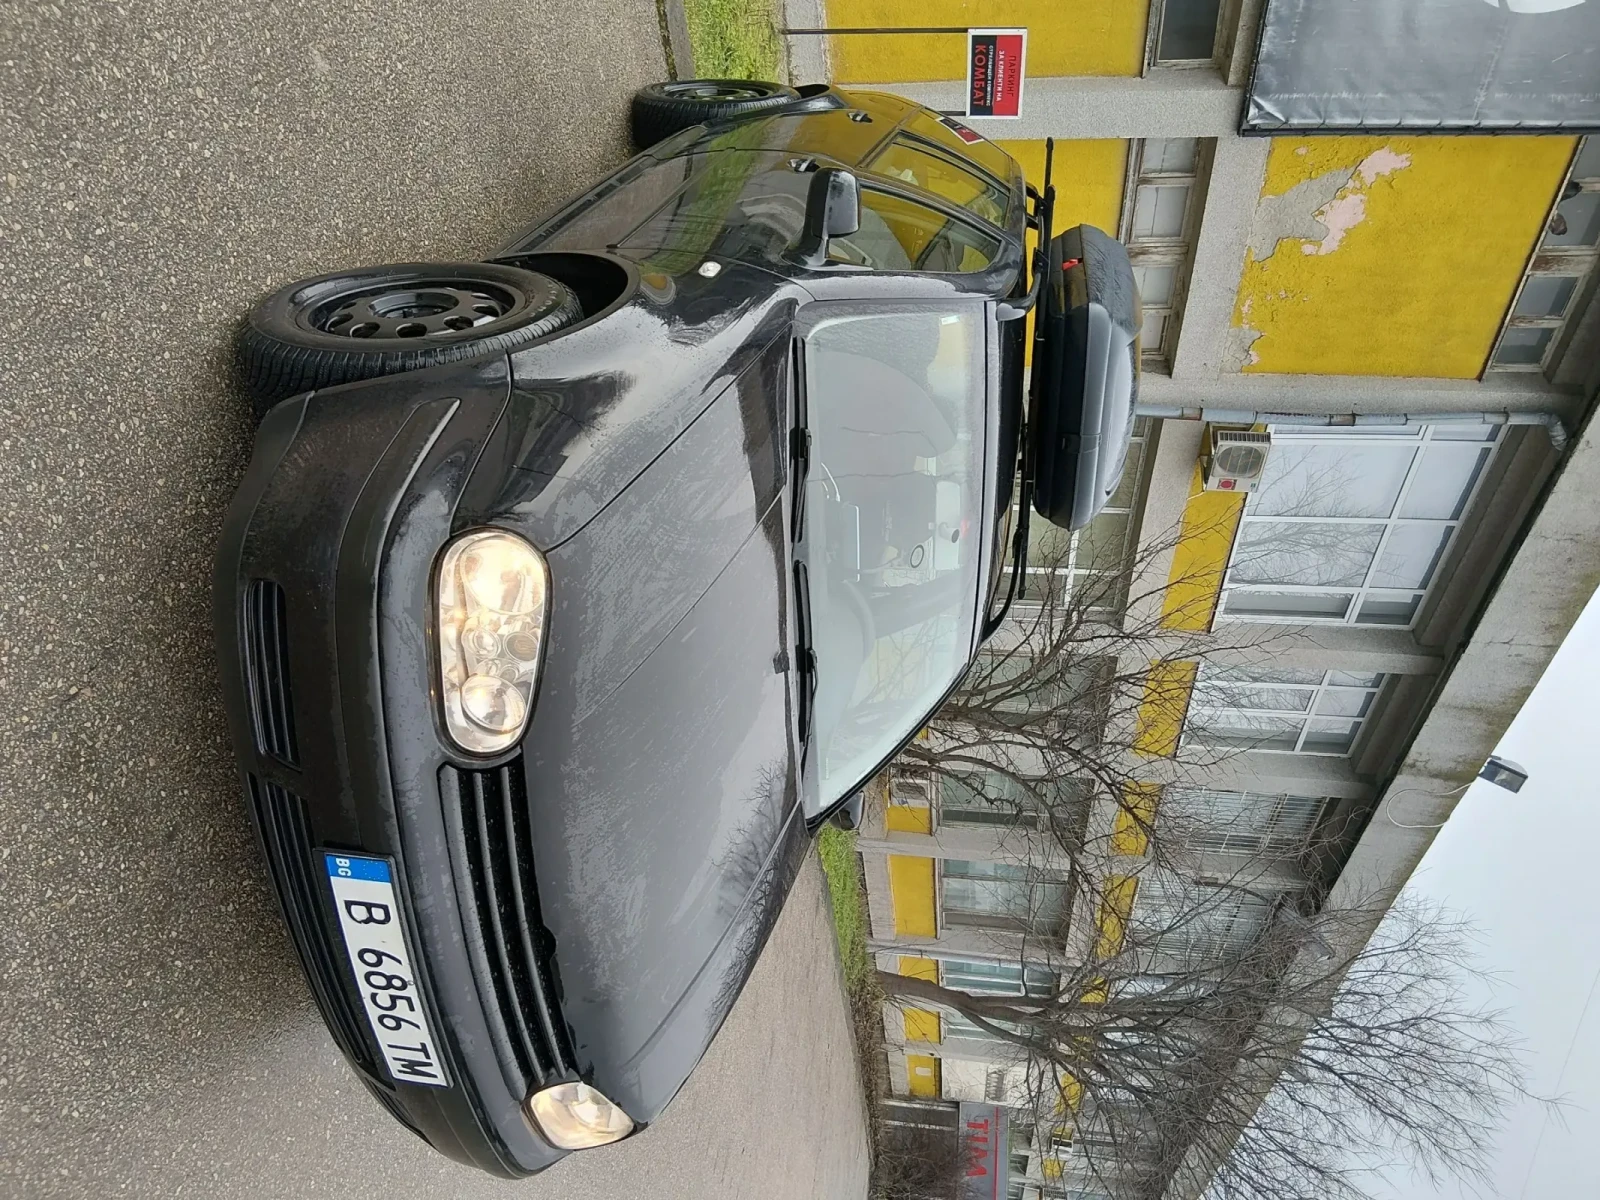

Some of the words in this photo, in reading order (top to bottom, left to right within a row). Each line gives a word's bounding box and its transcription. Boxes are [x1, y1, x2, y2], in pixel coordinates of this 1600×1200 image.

[998, 50, 1004, 60] ЗА
[973, 45, 986, 105] КОМБАТ
[1007, 55, 1017, 96] ПАРКИНГ
[996, 92, 1002, 102] НА
[336, 857, 351, 876] BG
[343, 899, 392, 925] B
[357, 947, 420, 1031] 6856
[387, 1042, 438, 1079] TM
